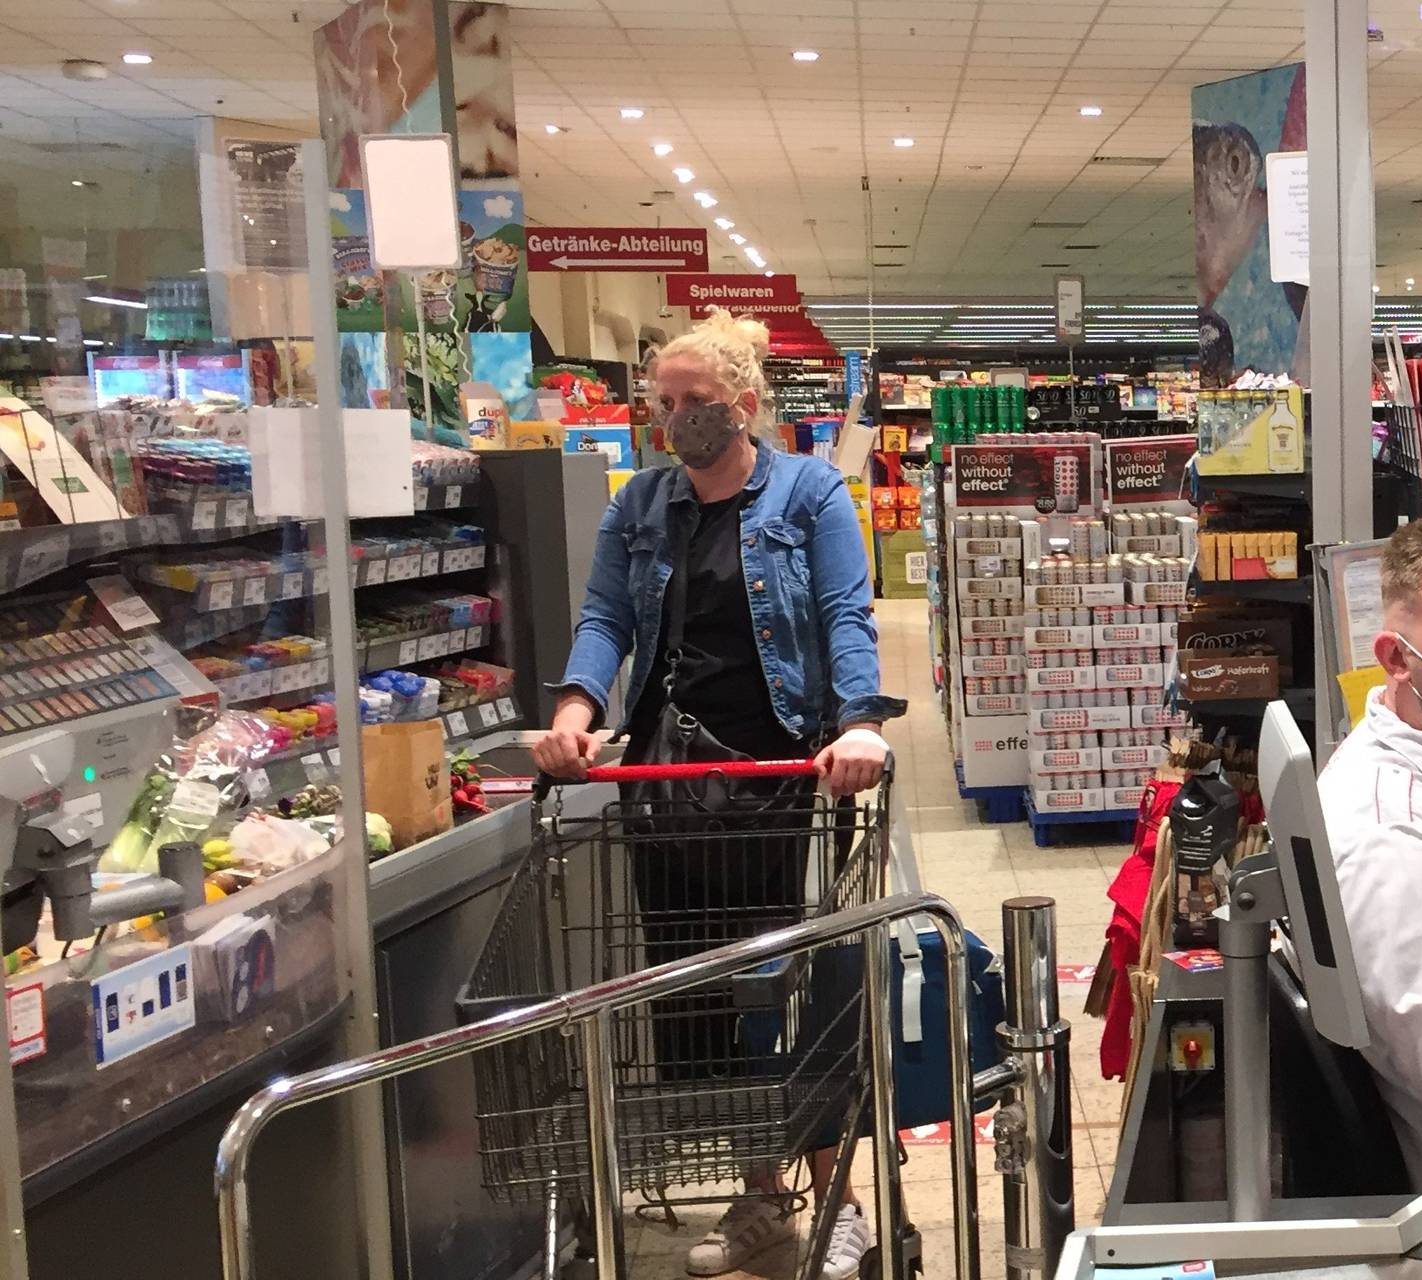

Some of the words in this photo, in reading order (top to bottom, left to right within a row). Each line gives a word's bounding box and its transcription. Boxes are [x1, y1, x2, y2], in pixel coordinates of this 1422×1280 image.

[528, 235, 704, 256] Getränke-Abteilung
[690, 284, 774, 298] Spielwaren
[961, 454, 978, 464] no
[979, 451, 1014, 465] effect
[1115, 452, 1132, 463] no
[1133, 449, 1167, 462] effect
[961, 465, 1013, 478] without
[1116, 462, 1166, 477] without
